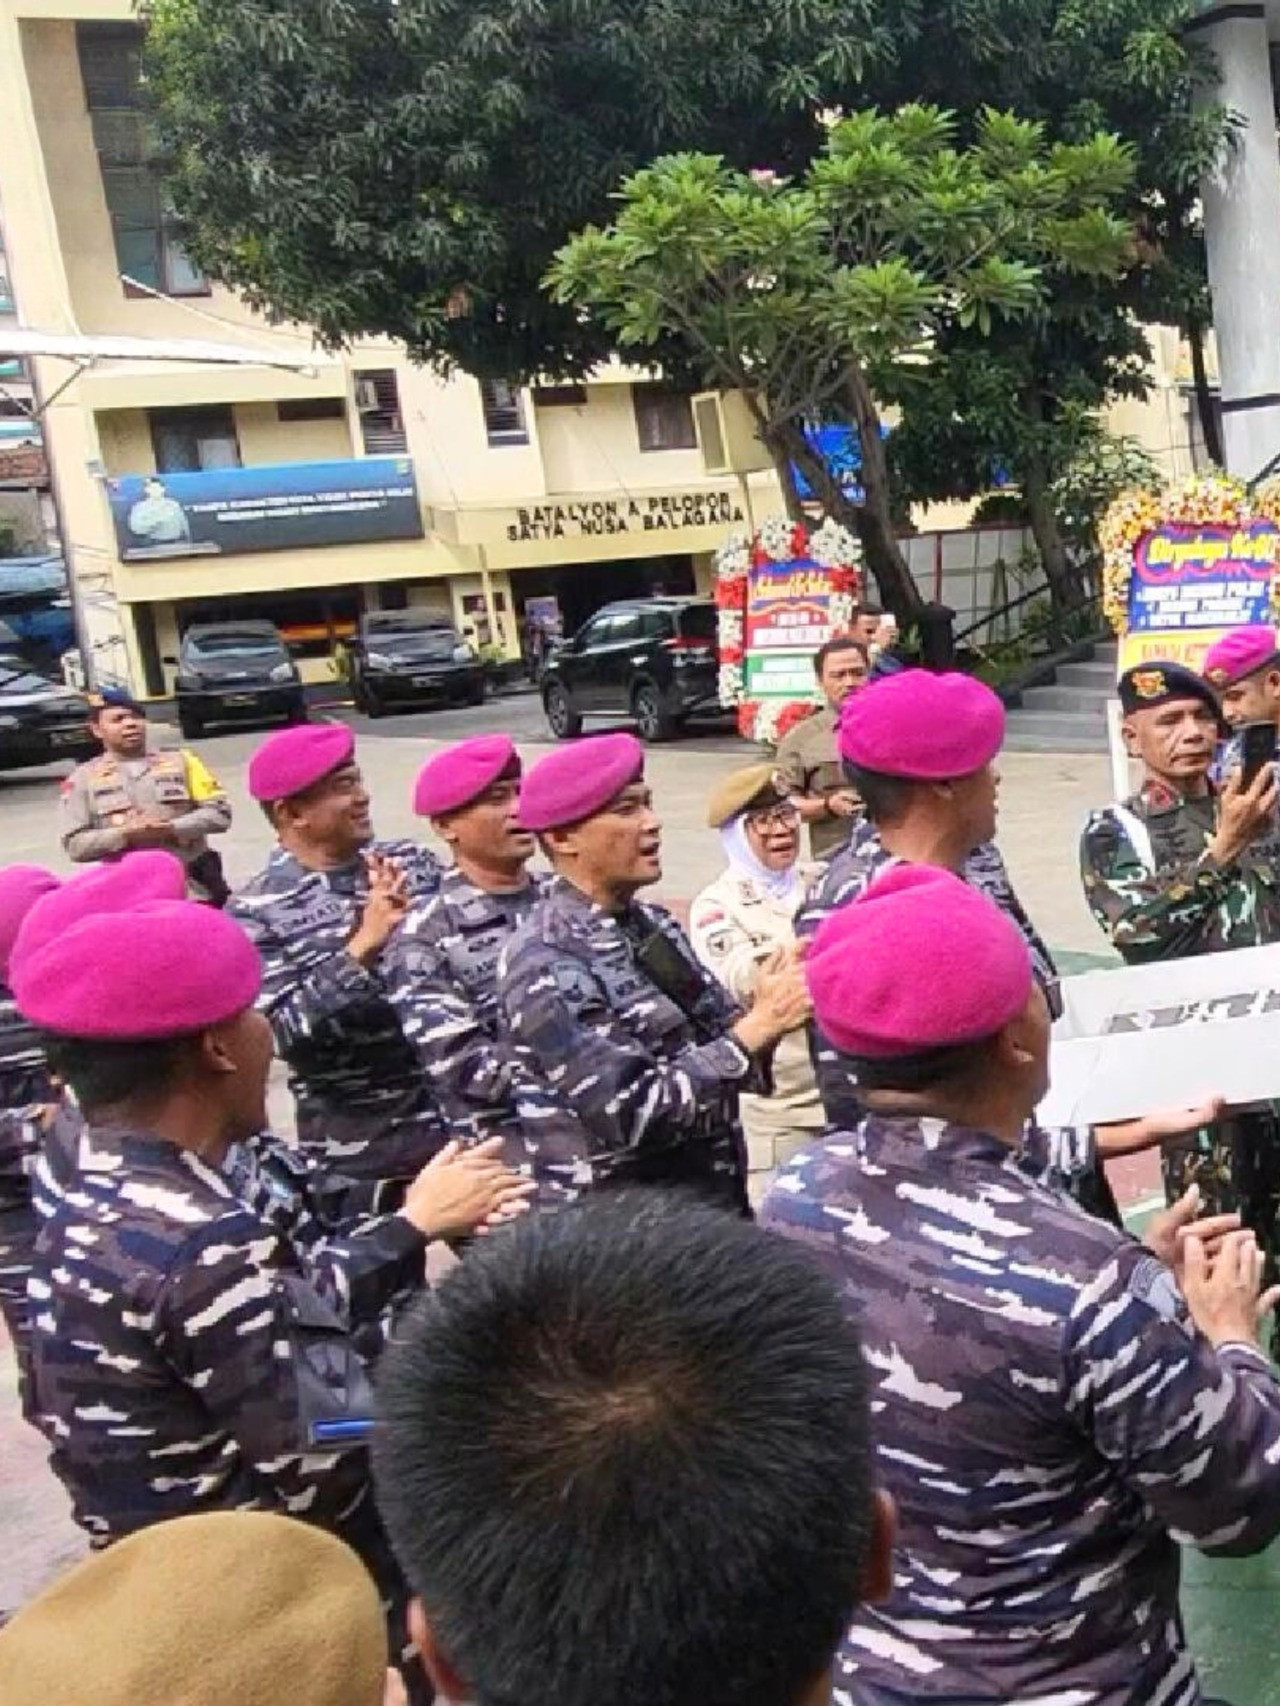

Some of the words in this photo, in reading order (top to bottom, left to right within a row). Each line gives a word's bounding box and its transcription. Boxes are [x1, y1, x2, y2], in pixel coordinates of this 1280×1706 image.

[507, 523, 565, 541] SATYA
[580, 517, 629, 535] NUSA
[642, 506, 744, 532] BALAGANA
[517, 501, 617, 526] BATALYON
[628, 500, 641, 517] A
[648, 492, 730, 512] PELOPOR
